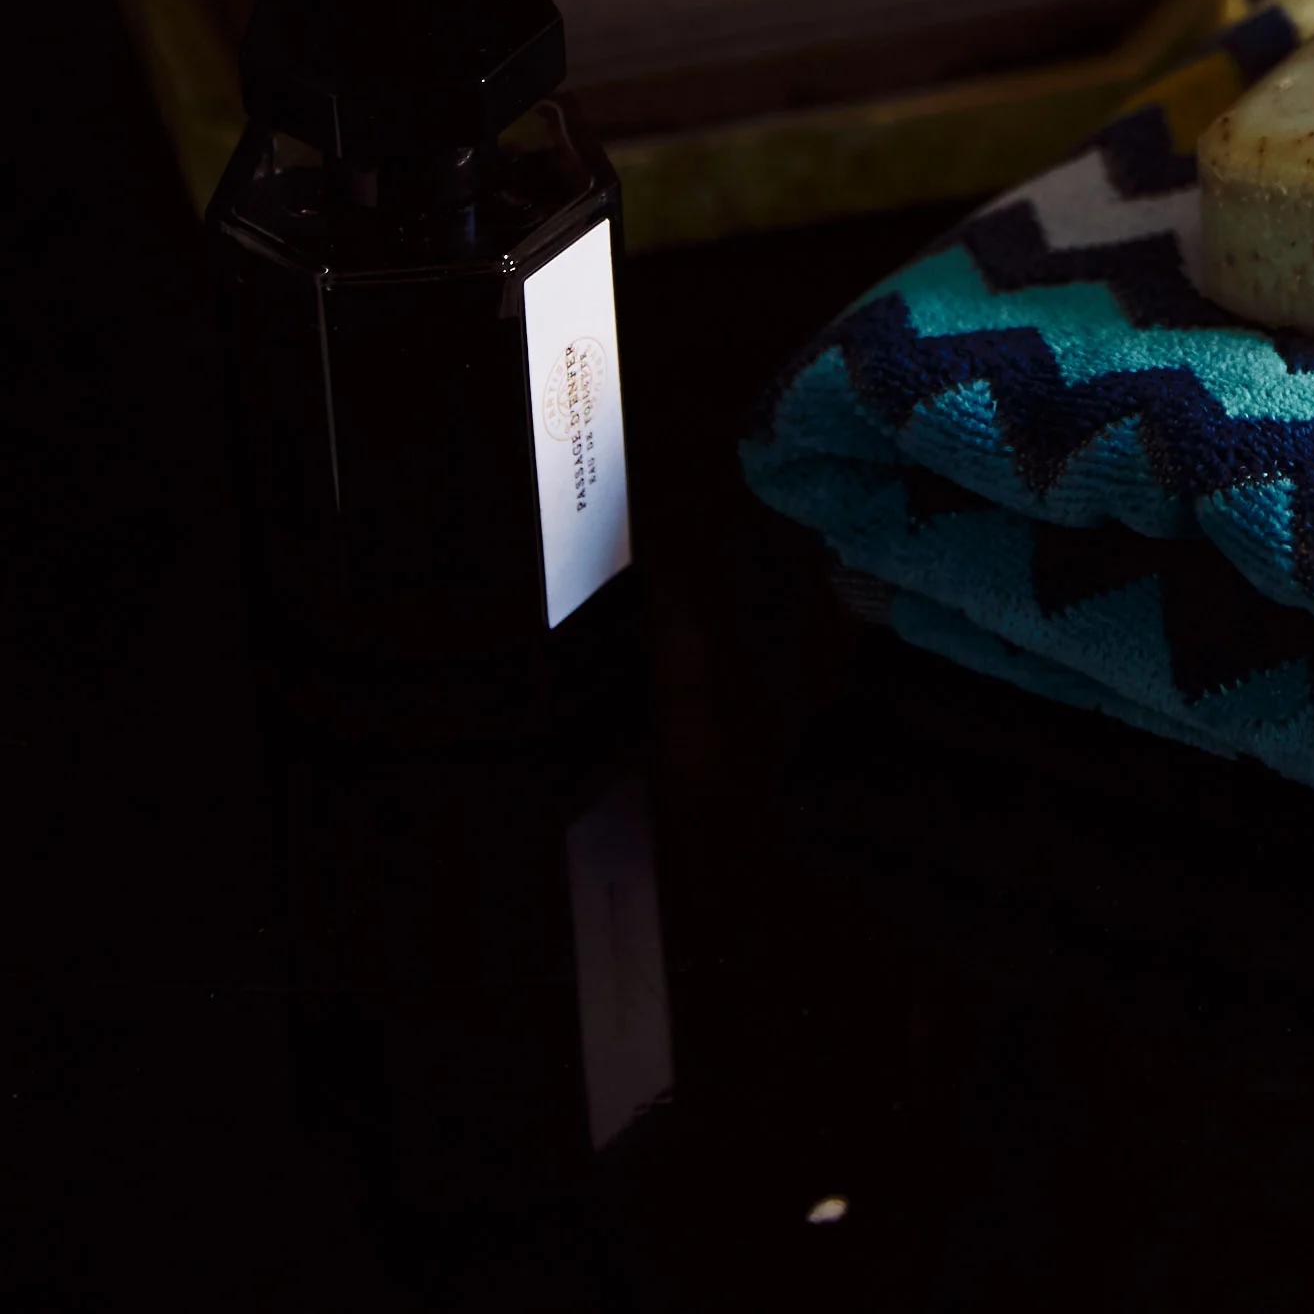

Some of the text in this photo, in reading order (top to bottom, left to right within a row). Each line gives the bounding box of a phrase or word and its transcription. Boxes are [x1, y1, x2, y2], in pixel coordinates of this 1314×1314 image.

[565, 342, 587, 512] PASSAGE D'ENFER
[585, 430, 595, 451] DE
[587, 457, 597, 485] EAU
